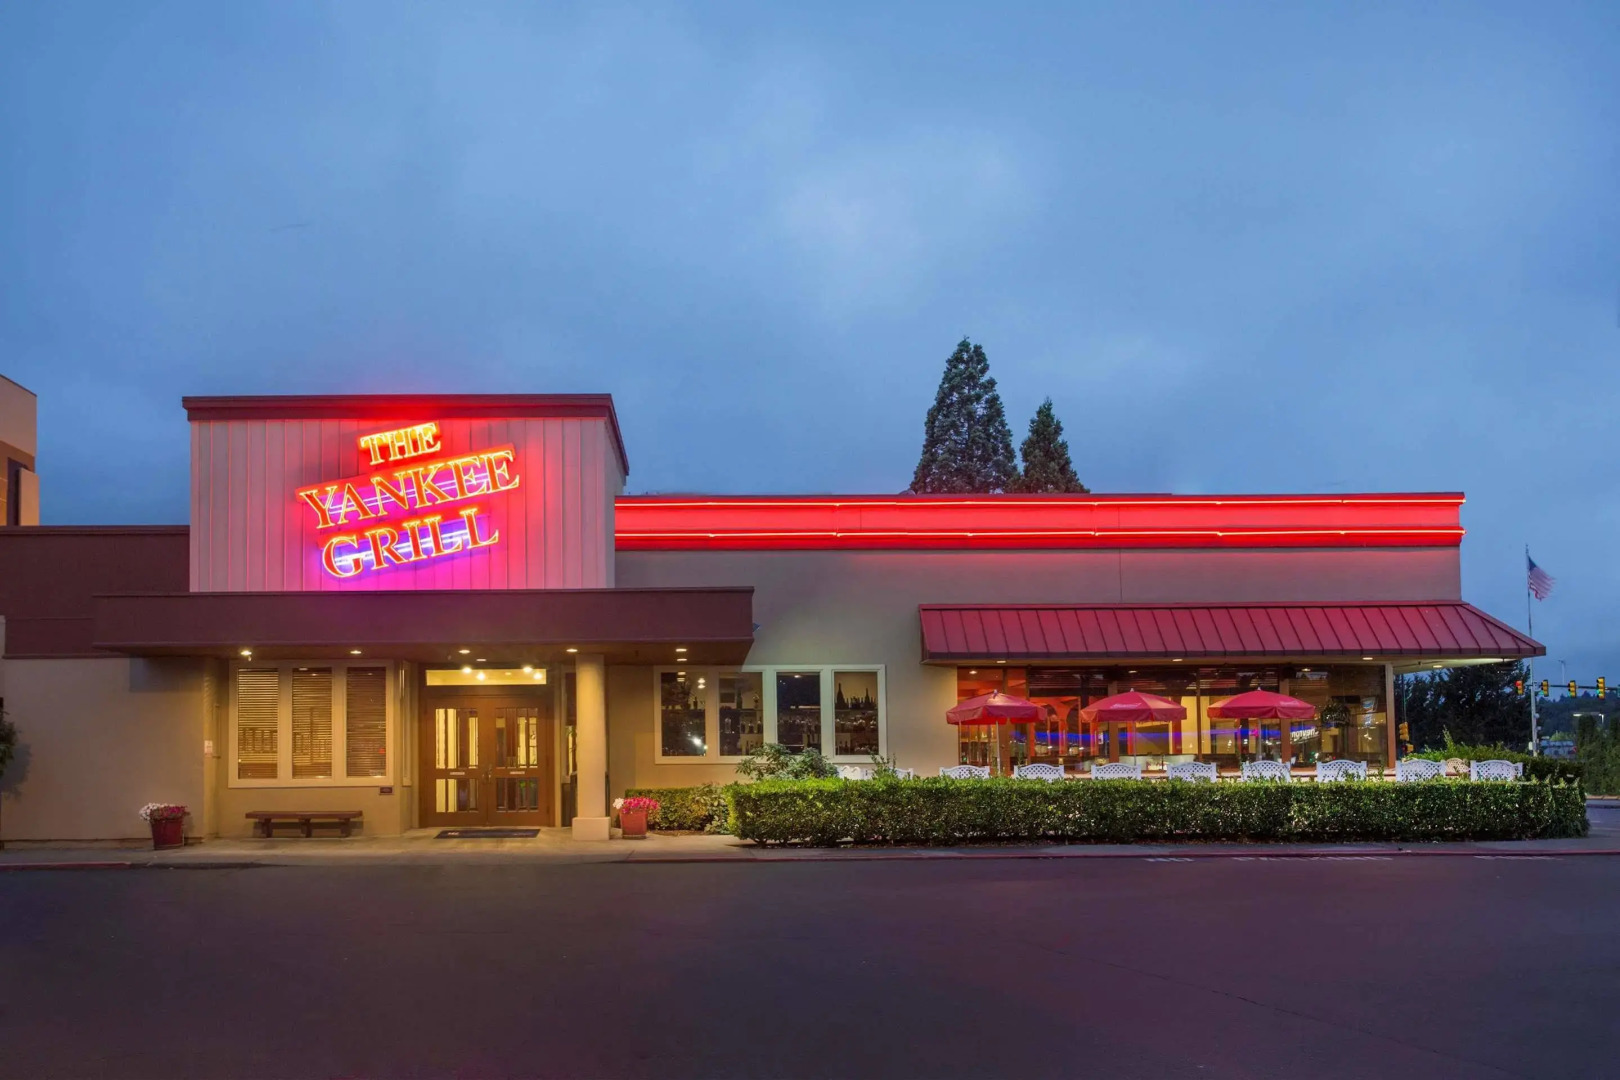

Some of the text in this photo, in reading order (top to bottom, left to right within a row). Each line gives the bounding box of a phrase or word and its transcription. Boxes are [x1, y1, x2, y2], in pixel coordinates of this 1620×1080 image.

[359, 421, 442, 466] THE
[299, 450, 520, 529] YANKEE
[322, 507, 499, 578] GRILL
